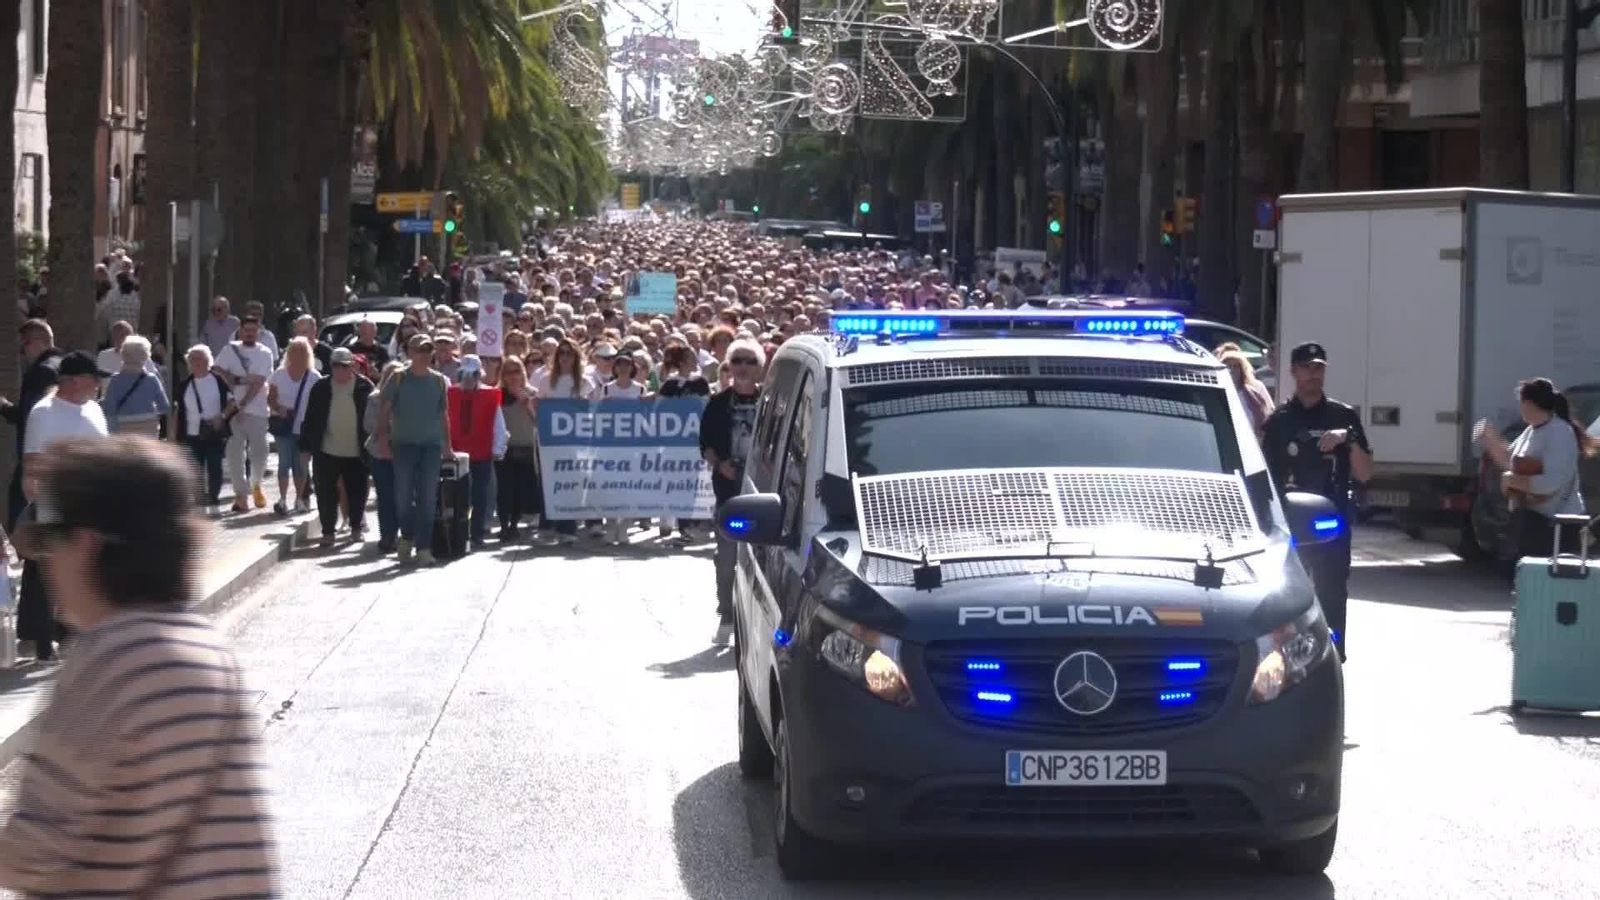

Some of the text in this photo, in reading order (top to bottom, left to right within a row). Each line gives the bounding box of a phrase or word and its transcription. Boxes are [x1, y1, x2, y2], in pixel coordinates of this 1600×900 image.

[553, 452, 712, 473] marea blanc
[553, 480, 580, 494] por
[582, 477, 597, 490] la
[600, 477, 662, 491] sanidad
[957, 604, 1156, 626] POLICIA
[1021, 754, 1161, 781] CNP3612BB
